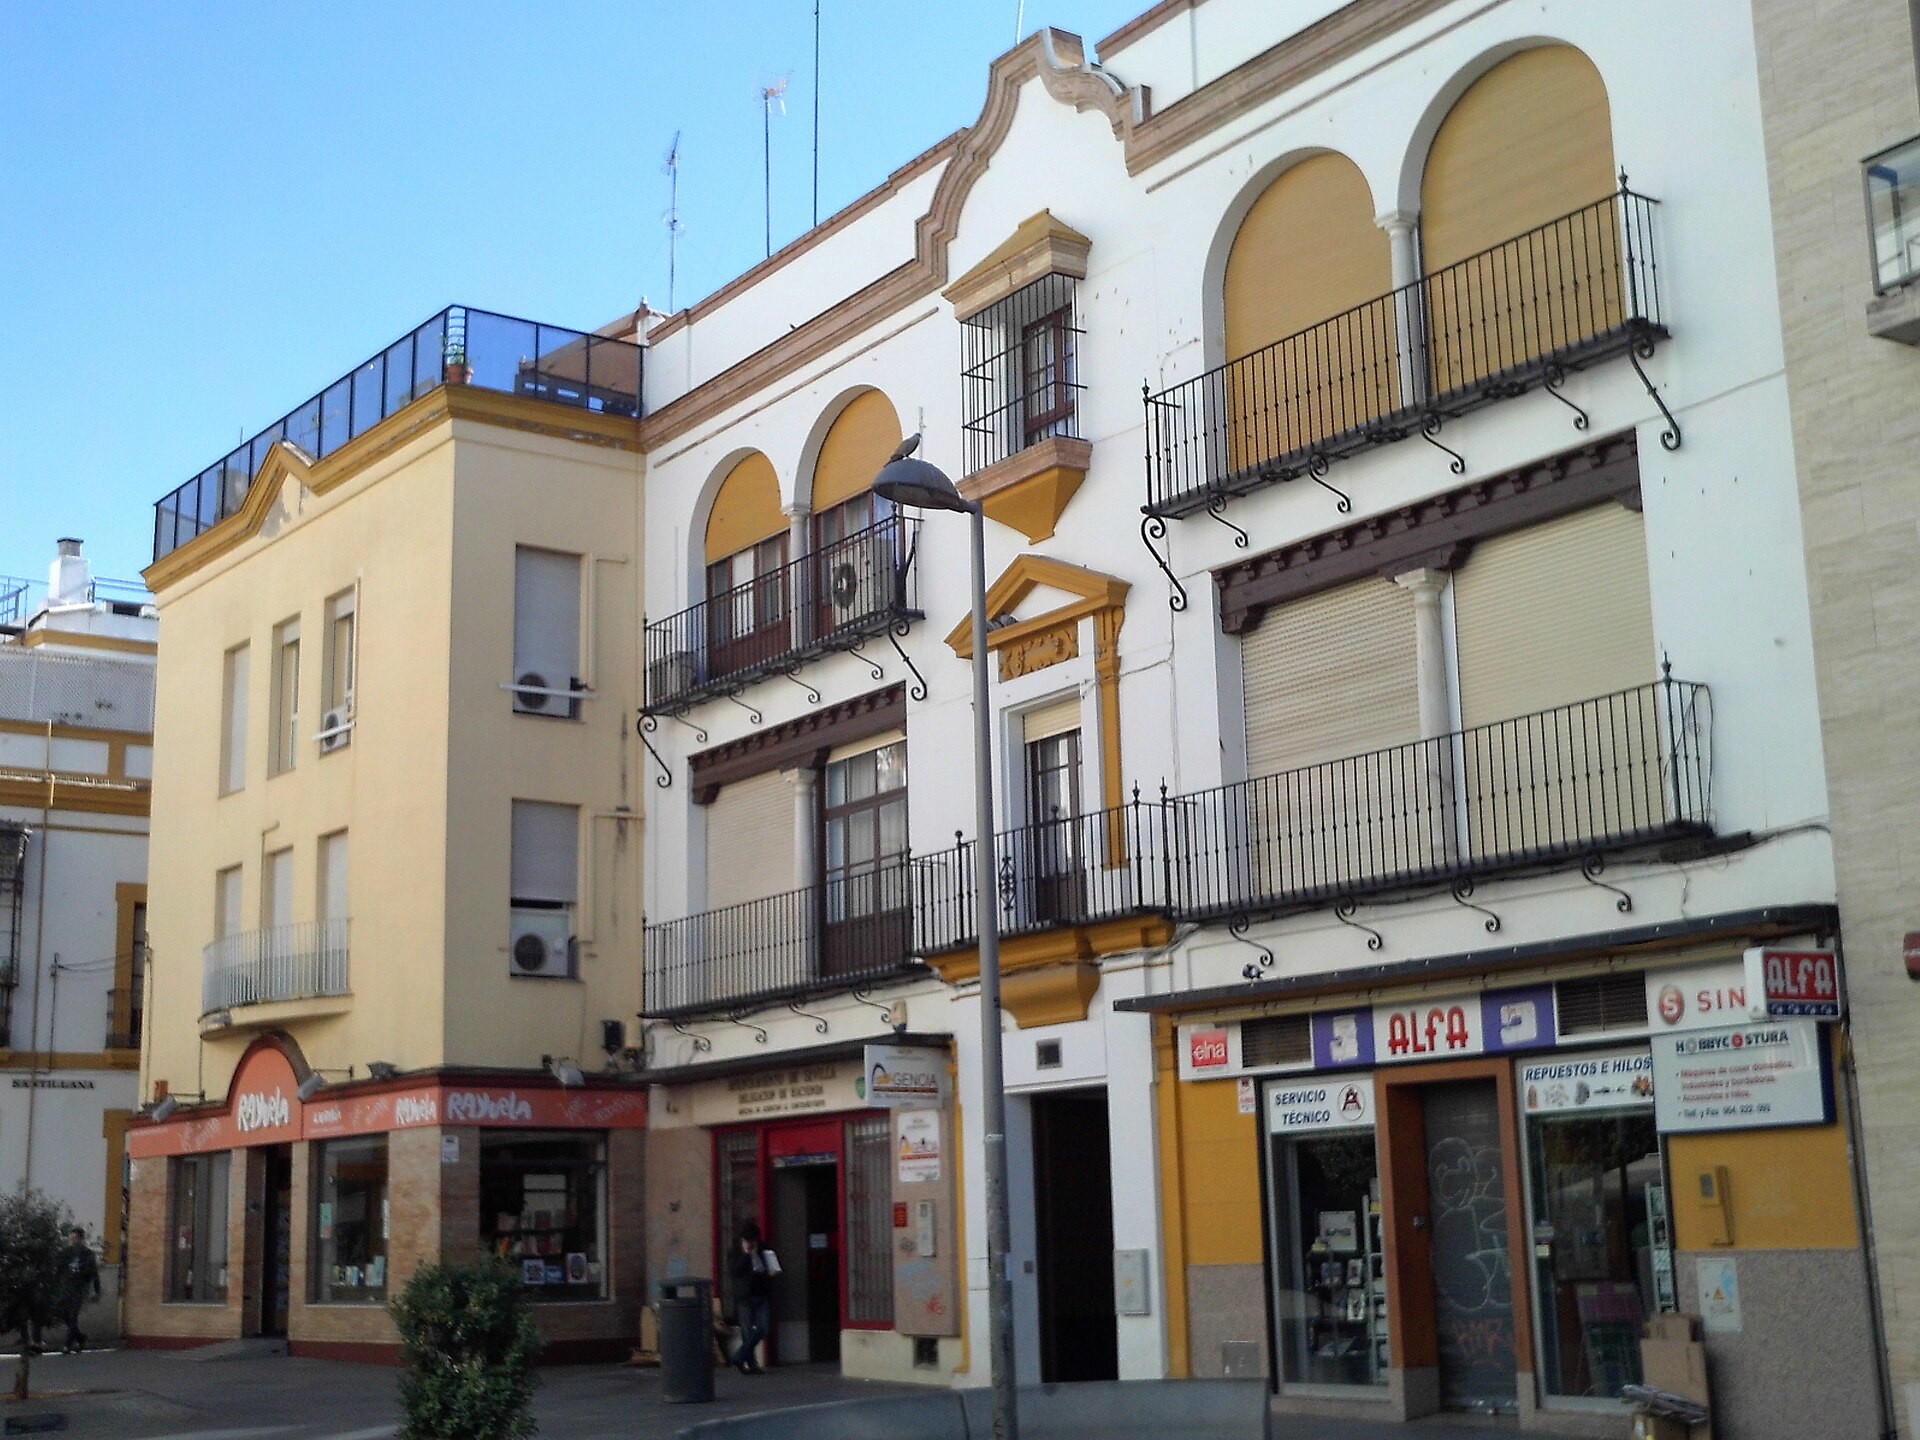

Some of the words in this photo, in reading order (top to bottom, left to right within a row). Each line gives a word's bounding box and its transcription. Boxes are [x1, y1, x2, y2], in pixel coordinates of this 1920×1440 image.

[1767, 957, 1832, 995] ALFA
[1388, 1006, 1469, 1056] ALFA
[1193, 1041, 1226, 1061] elna
[1525, 1062, 1598, 1082] REPUESTOS
[1601, 1060, 1609, 1074] E
[1612, 1056, 1653, 1073] HILOS
[1275, 1089, 1326, 1106] SERVICIO
[1283, 1109, 1331, 1125] TÉCNICO
